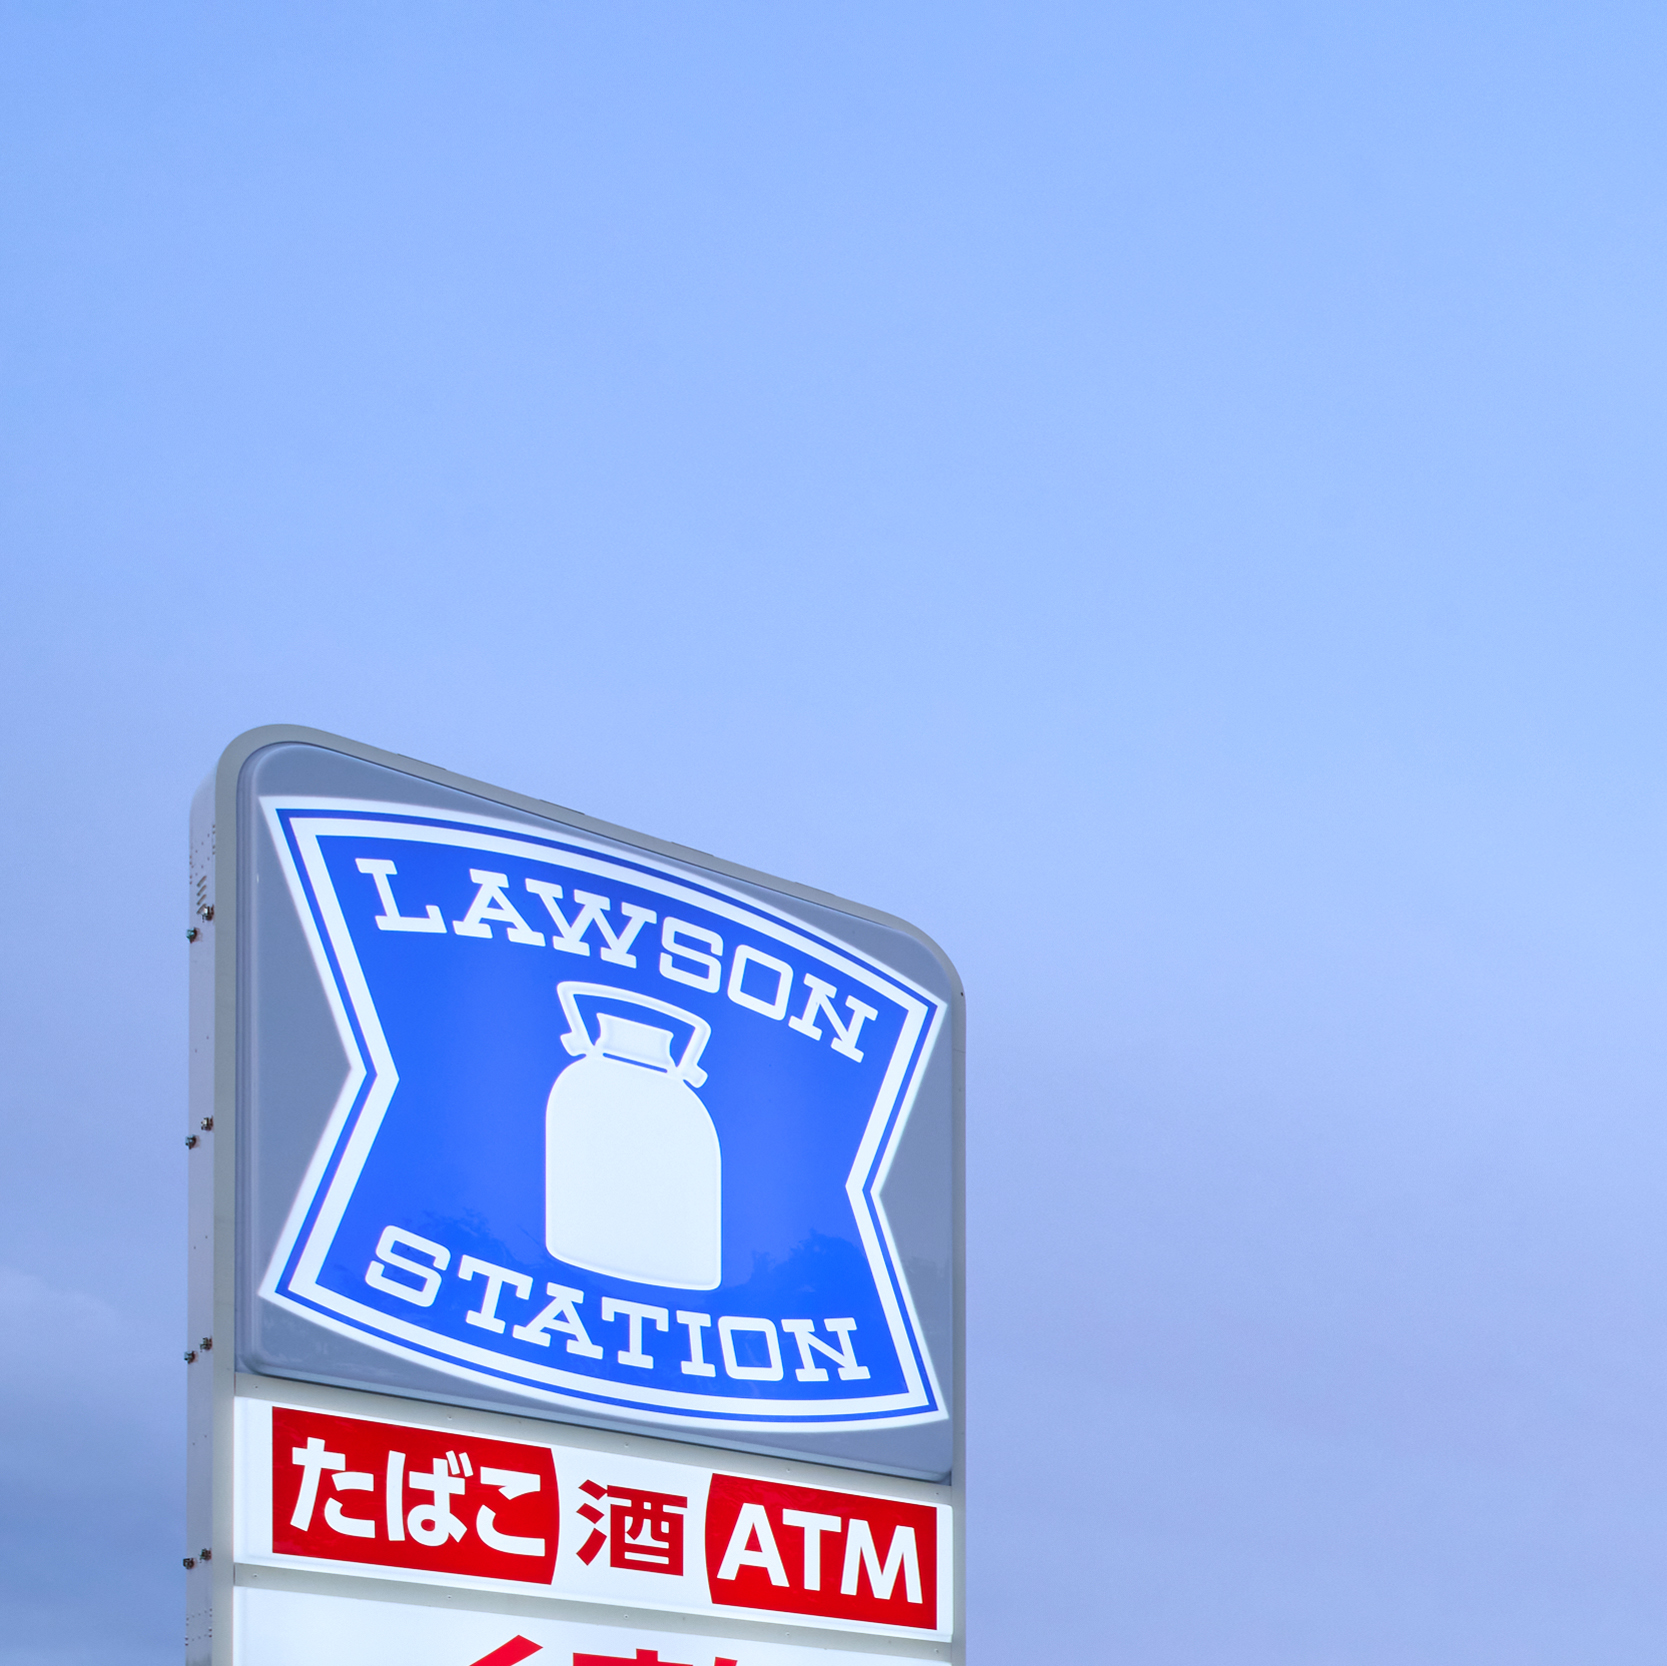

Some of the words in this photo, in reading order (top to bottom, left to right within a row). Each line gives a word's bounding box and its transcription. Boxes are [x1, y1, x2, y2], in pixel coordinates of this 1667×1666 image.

[354, 857, 880, 1064] LAWSON
[363, 1225, 872, 1383] STATION
[290, 1437, 547, 1558] たばこ
[575, 1477, 689, 1578] 酒
[716, 1506, 925, 1606] ATM
